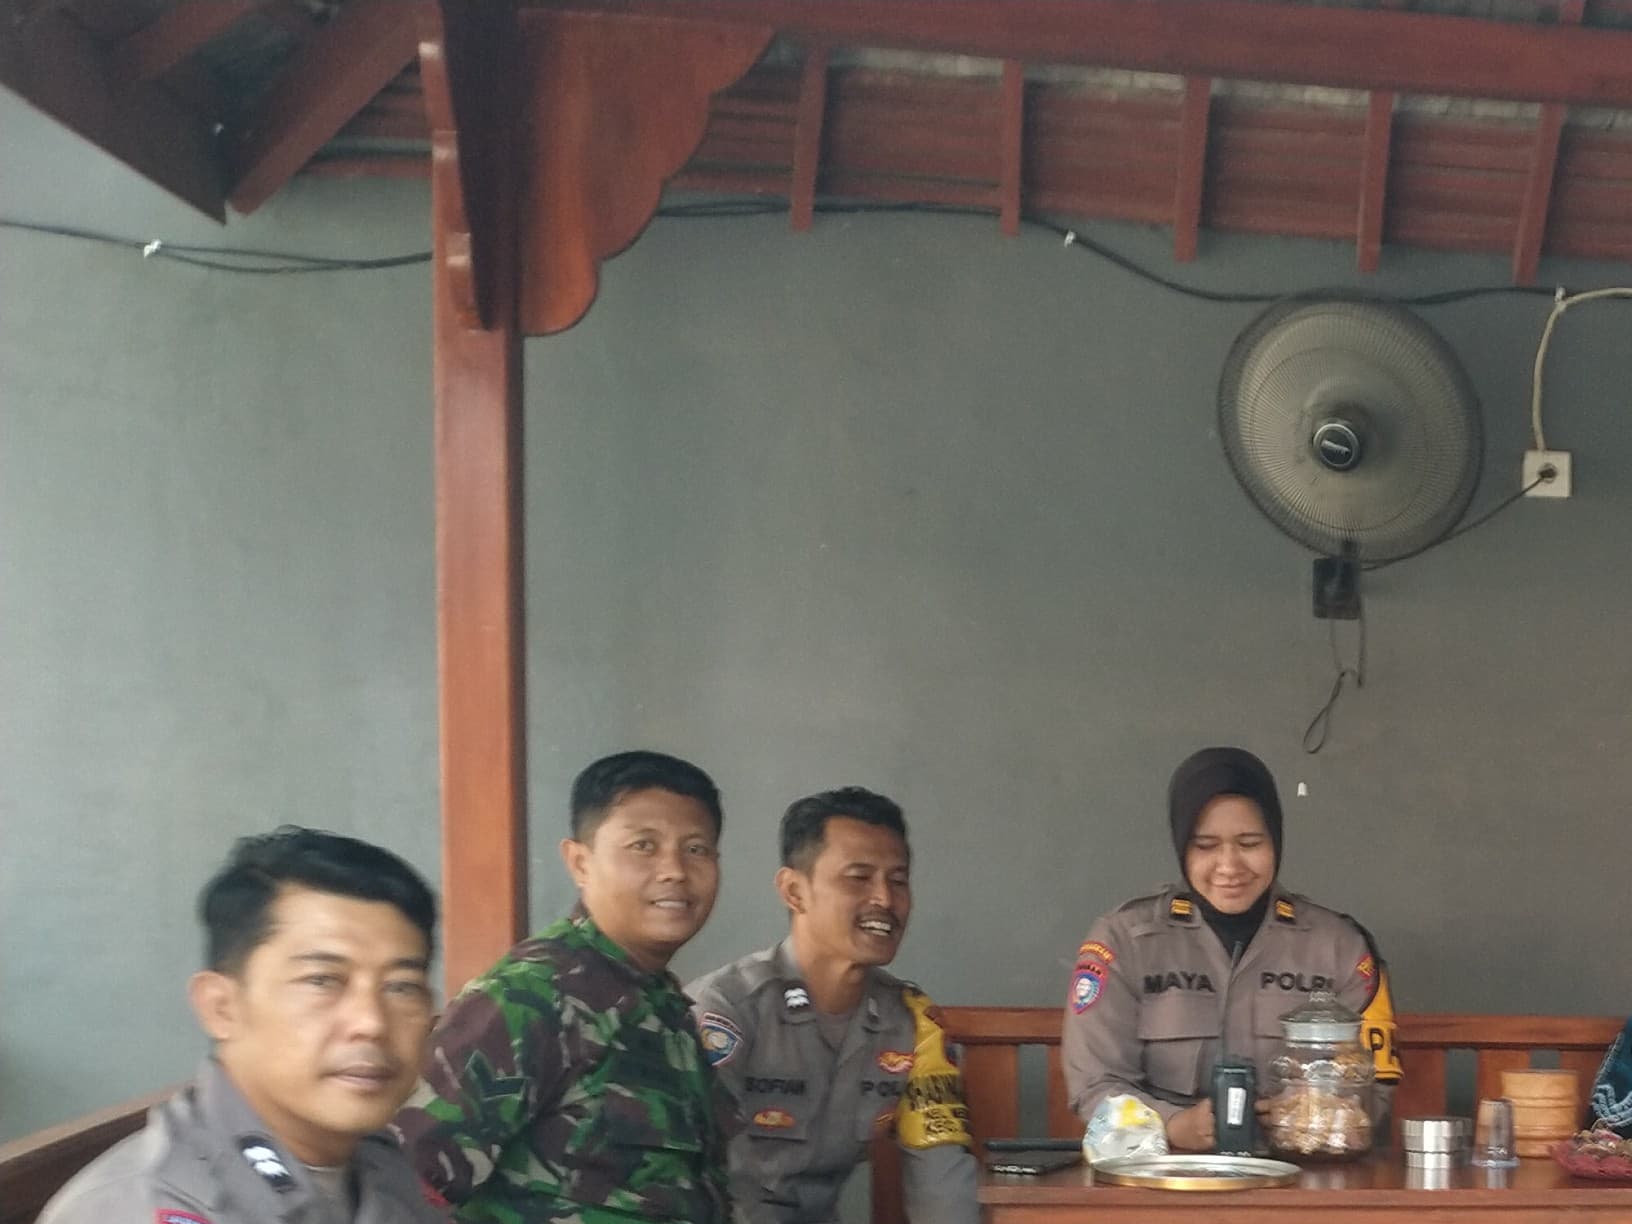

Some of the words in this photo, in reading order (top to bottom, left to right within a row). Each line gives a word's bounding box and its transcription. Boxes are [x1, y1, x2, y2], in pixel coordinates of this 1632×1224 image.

[1144, 971, 1216, 993] MAYA
[1261, 972, 1334, 992] POLRI
[861, 1080, 903, 1098] POL
